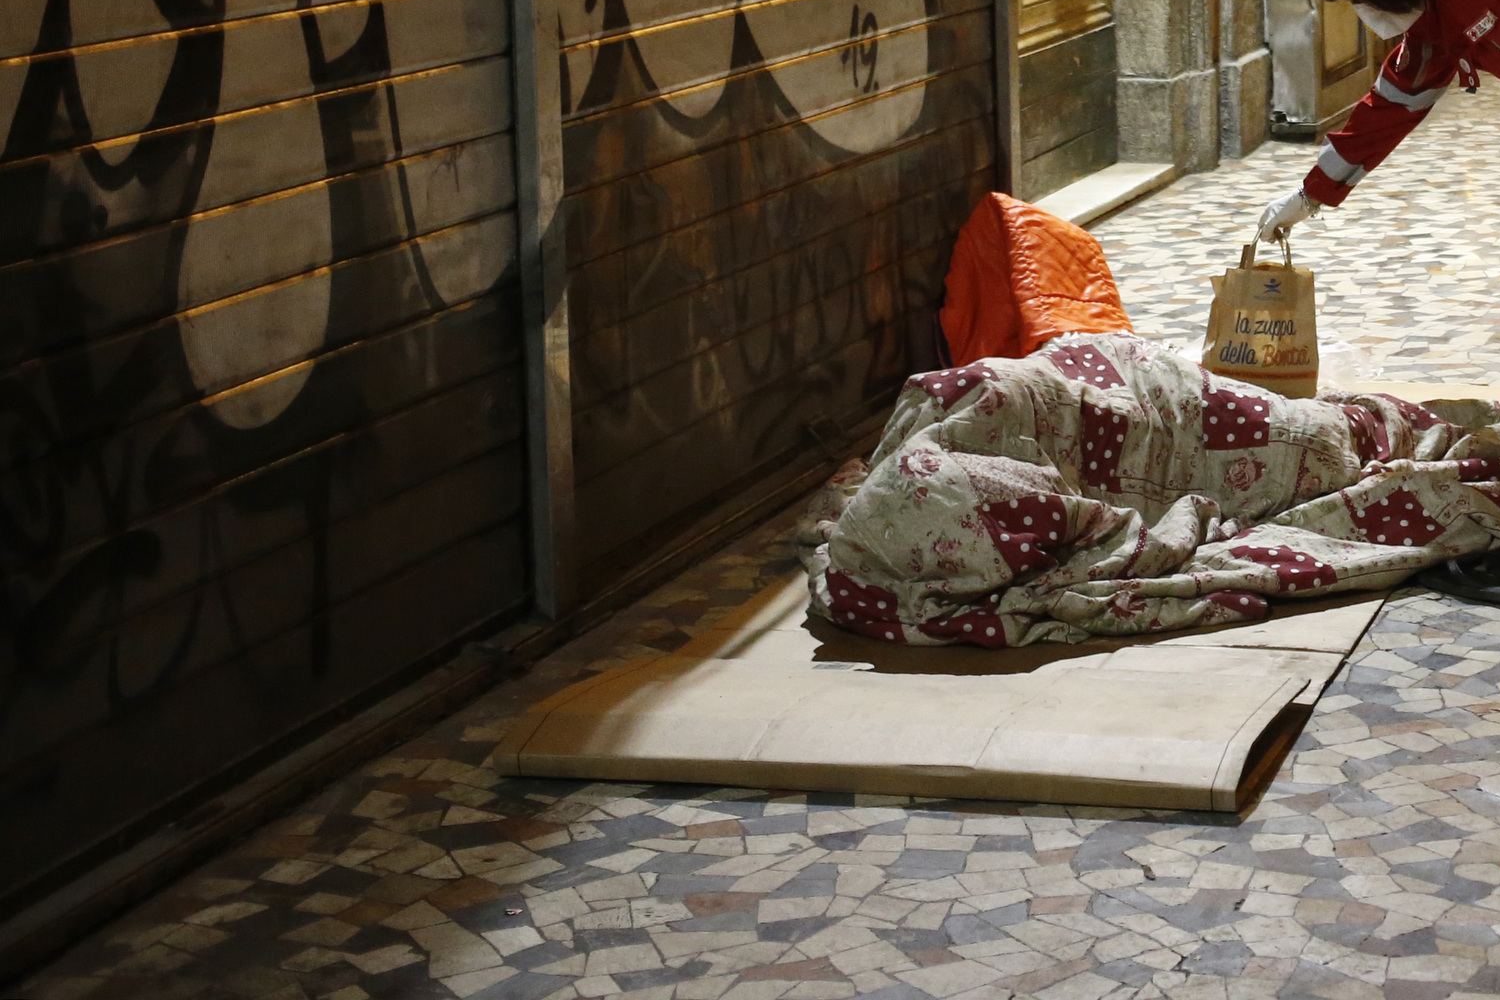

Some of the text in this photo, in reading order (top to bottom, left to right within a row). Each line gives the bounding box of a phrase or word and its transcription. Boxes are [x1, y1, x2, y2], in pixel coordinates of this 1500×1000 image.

[1234, 311, 1297, 341] la zuppa
[1219, 340, 1258, 365] della
